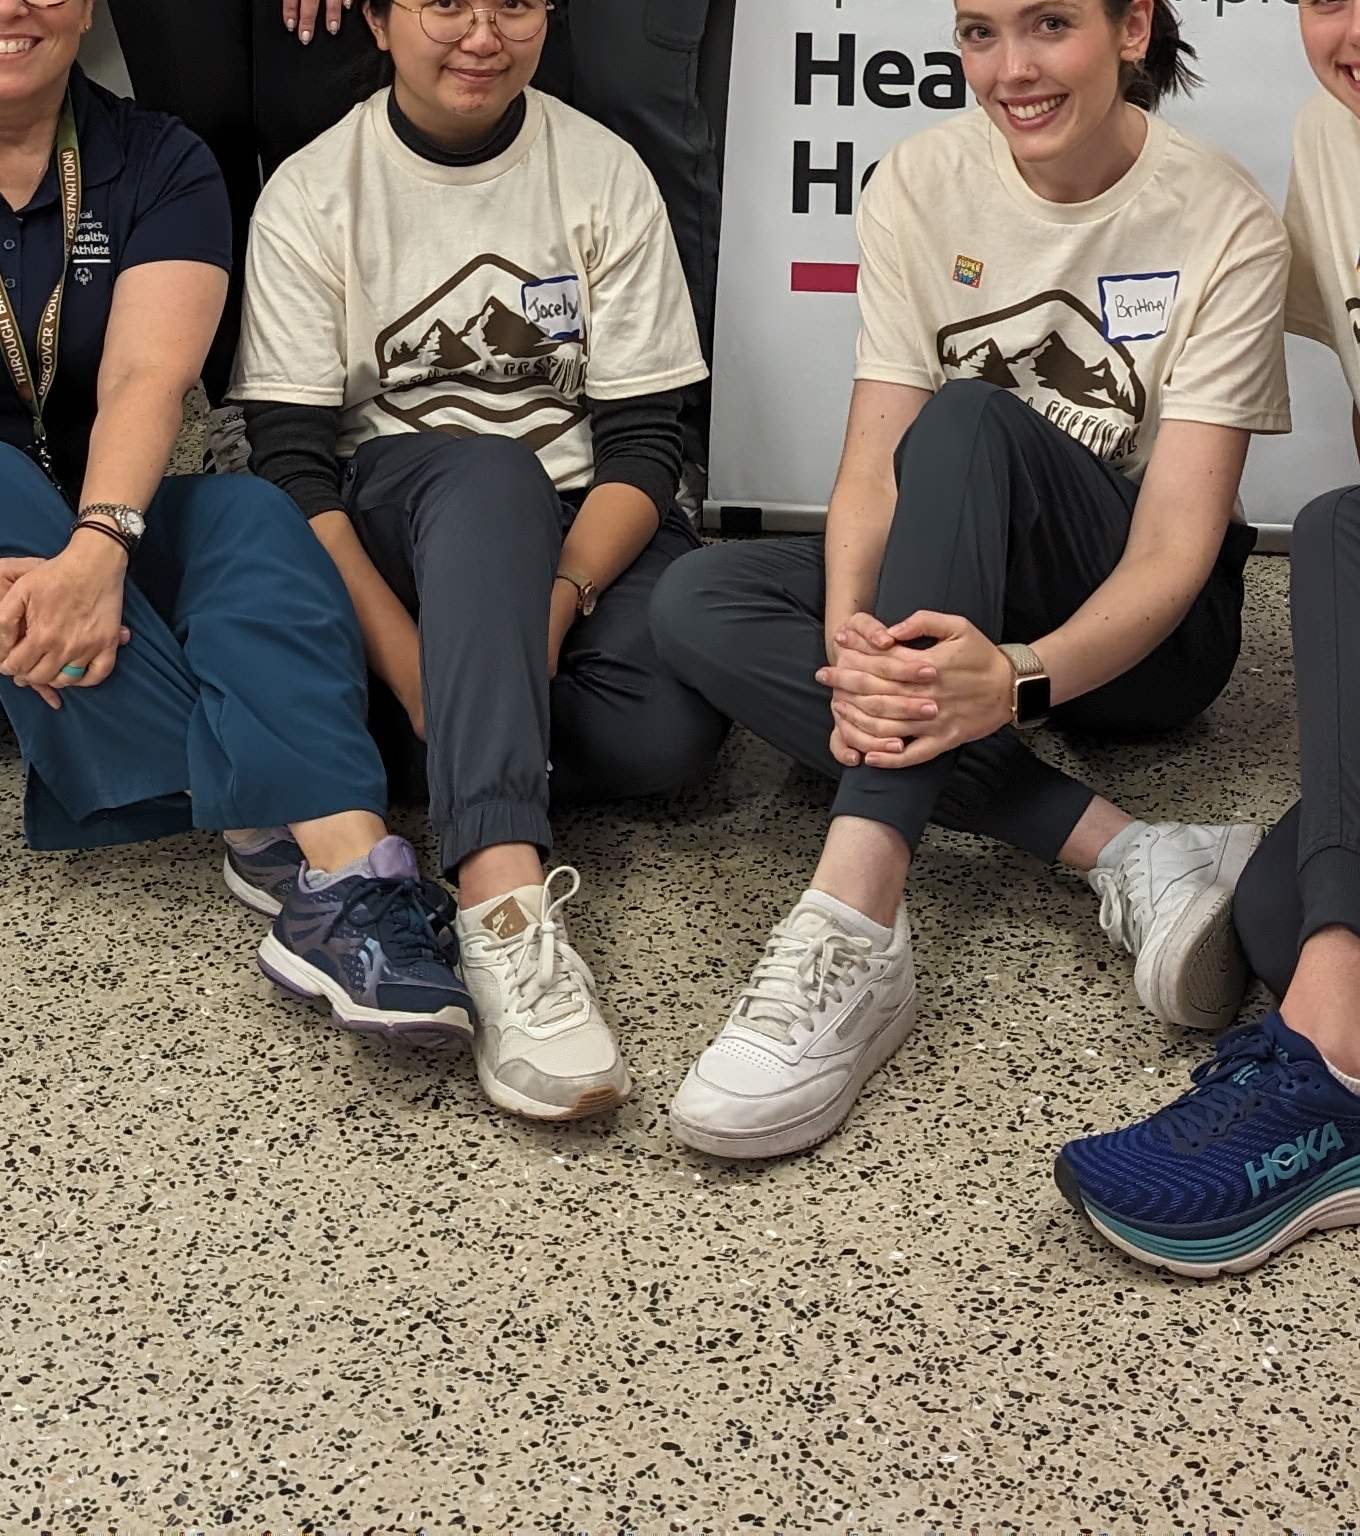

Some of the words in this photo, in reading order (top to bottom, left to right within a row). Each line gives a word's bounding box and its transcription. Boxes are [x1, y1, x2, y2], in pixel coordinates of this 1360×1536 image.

[527, 292, 579, 323] Jocely
[37, 327, 54, 396] DISCOVER
[1244, 1121, 1347, 1198] HOKA
